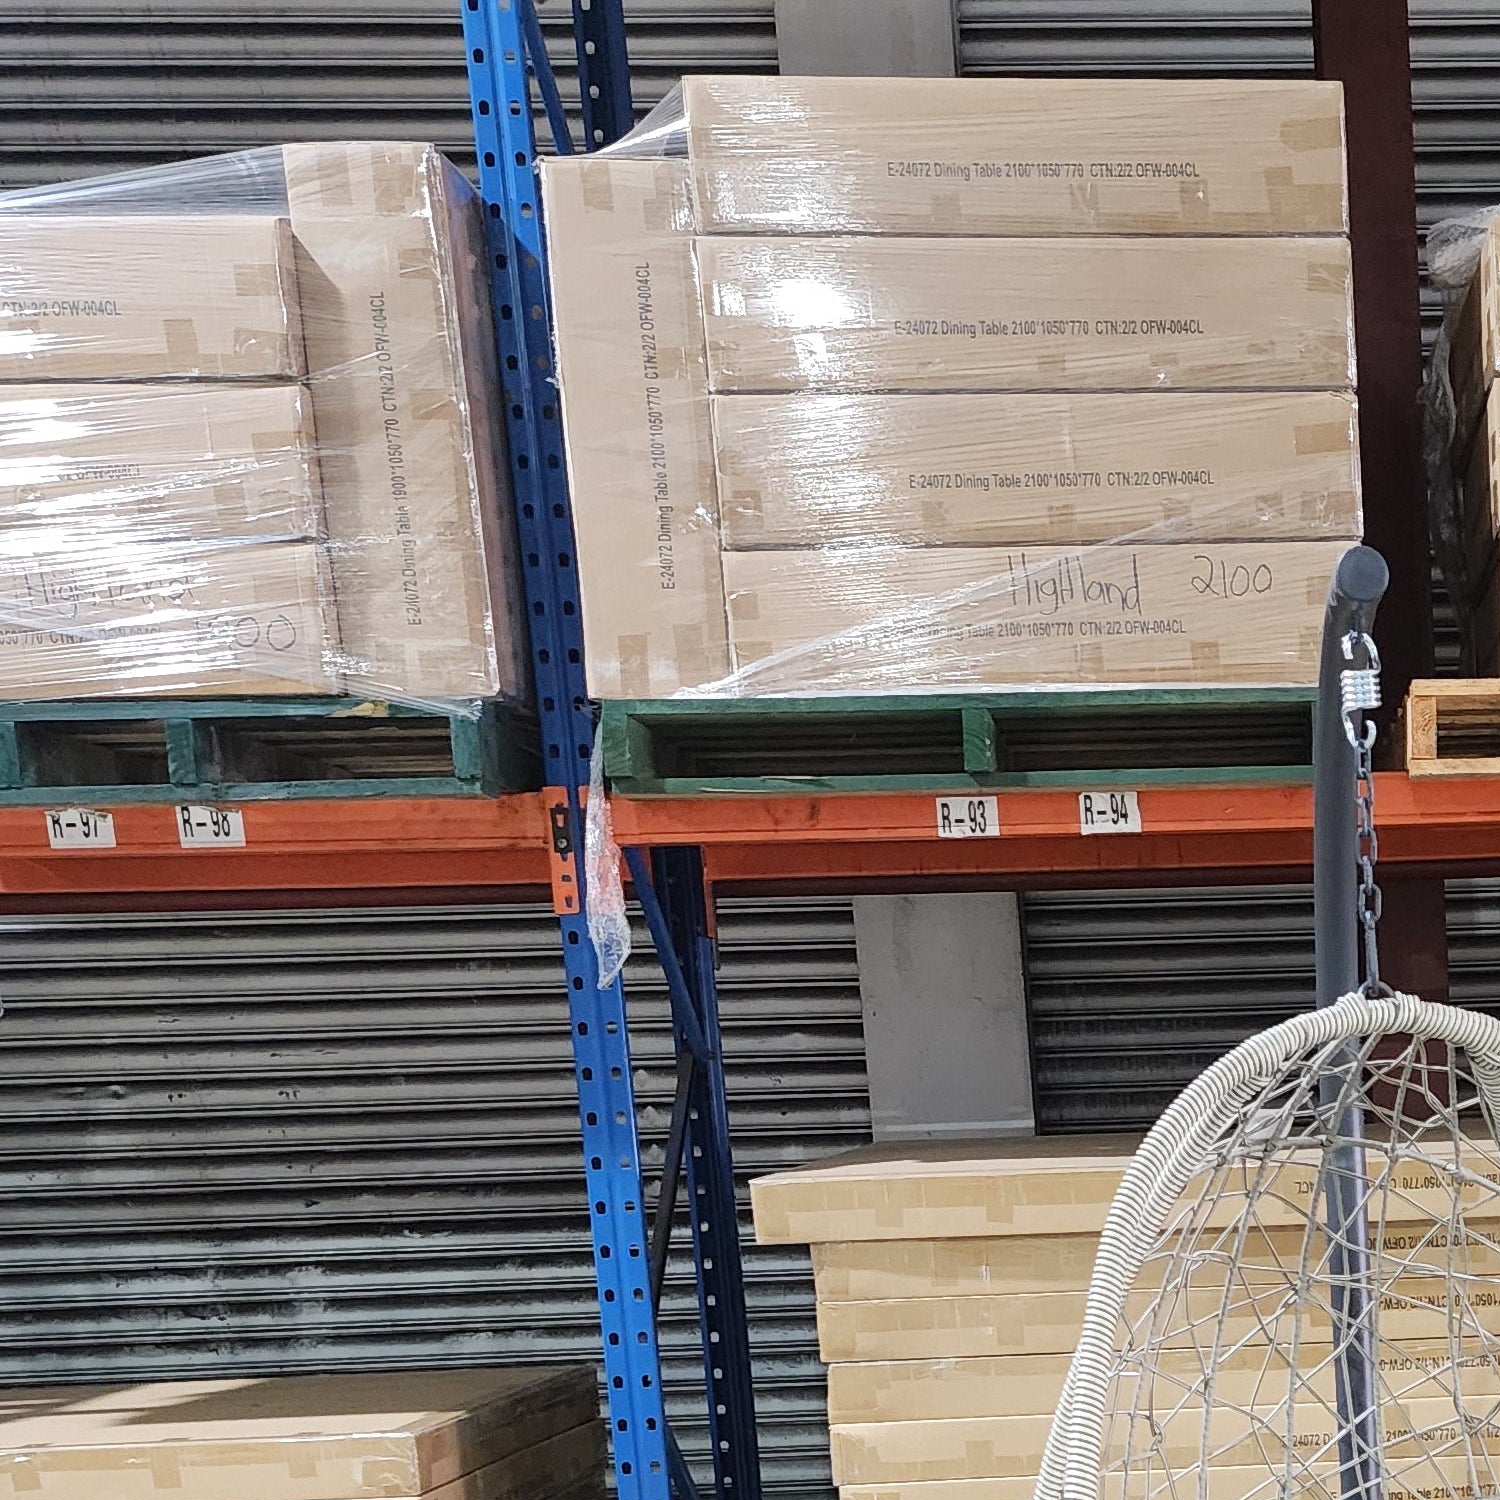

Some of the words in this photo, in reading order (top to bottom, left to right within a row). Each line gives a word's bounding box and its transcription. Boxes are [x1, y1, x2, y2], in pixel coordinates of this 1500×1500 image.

[888, 162, 931, 178] E-24072
[934, 161, 971, 181] Dining
[973, 161, 1002, 178] Table
[1090, 162, 1133, 178] CTN:2/2
[1136, 161, 1200, 178] OFW-004CL
[635, 262, 655, 331] OFW-004CL
[894, 321, 937, 336] E-24072
[941, 320, 976, 338] Dining
[979, 320, 1008, 336] Table
[1095, 320, 1138, 335] CTN:2/2
[1140, 320, 1204, 335] OFW-004CL
[641, 334, 659, 381] CTN:2/2
[654, 471, 669, 502] Table
[909, 475, 952, 489] E-24072
[955, 474, 989, 491] Dining
[992, 473, 1021, 488] Table
[1107, 472, 1150, 486] CTN:2/2
[1152, 470, 1215, 486] OFW-004CL
[396, 506, 411, 537] Table
[657, 505, 674, 543] Dining
[399, 539, 417, 577] Dining
[660, 544, 676, 590] E-24072
[1191, 554, 1273, 598] 2100
[1080, 620, 1122, 636] CTN:2/2
[1125, 620, 1187, 635] OFW-004CL
[181, 806, 231, 838] R-98
[941, 800, 987, 834] R-93
[1084, 794, 1129, 825] R-94
